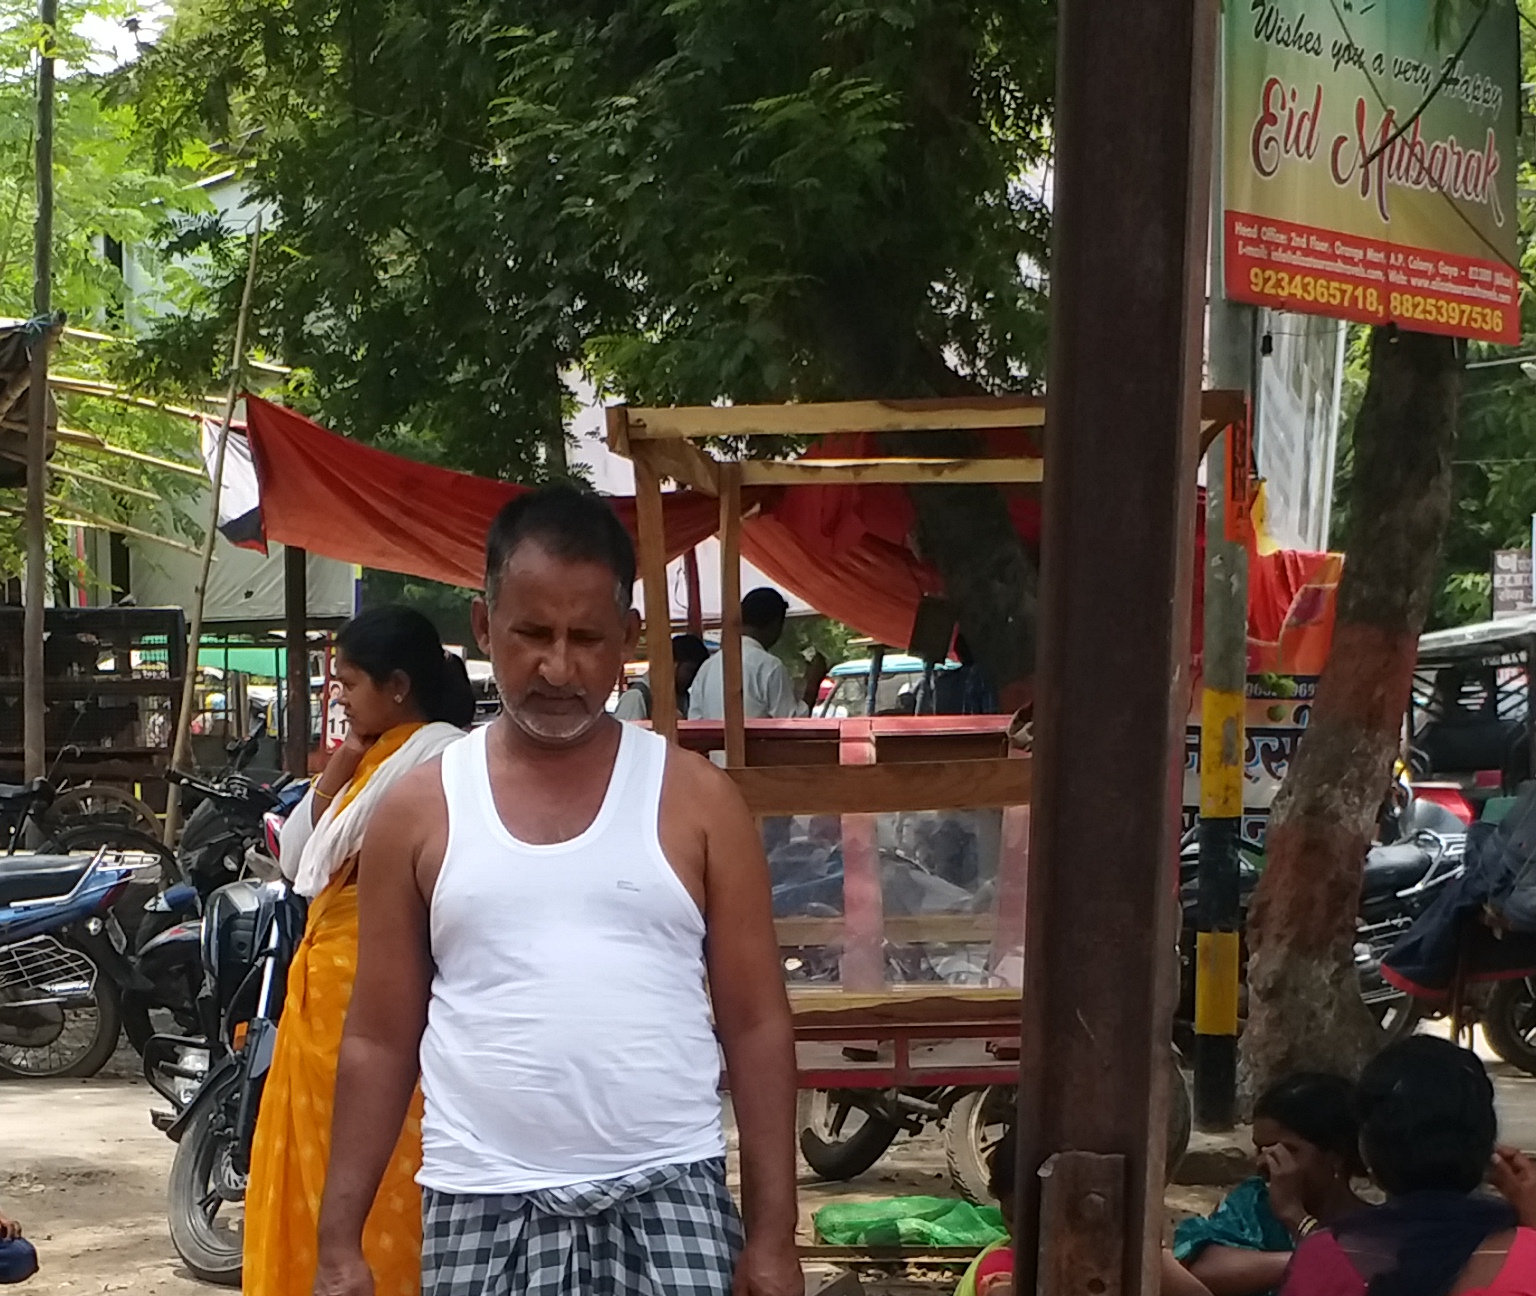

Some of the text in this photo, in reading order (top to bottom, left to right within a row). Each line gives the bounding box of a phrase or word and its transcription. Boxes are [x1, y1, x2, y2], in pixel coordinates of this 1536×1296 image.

[1250, 2, 1323, 57] Wishes
[1331, 36, 1366, 73] you
[1372, 51, 1386, 76] a
[1393, 56, 1433, 96] very
[1251, 76, 1505, 226] Eid Mubarak
[1249, 267, 1384, 318] 9234365718,
[1390, 292, 1504, 334] 8825397536
